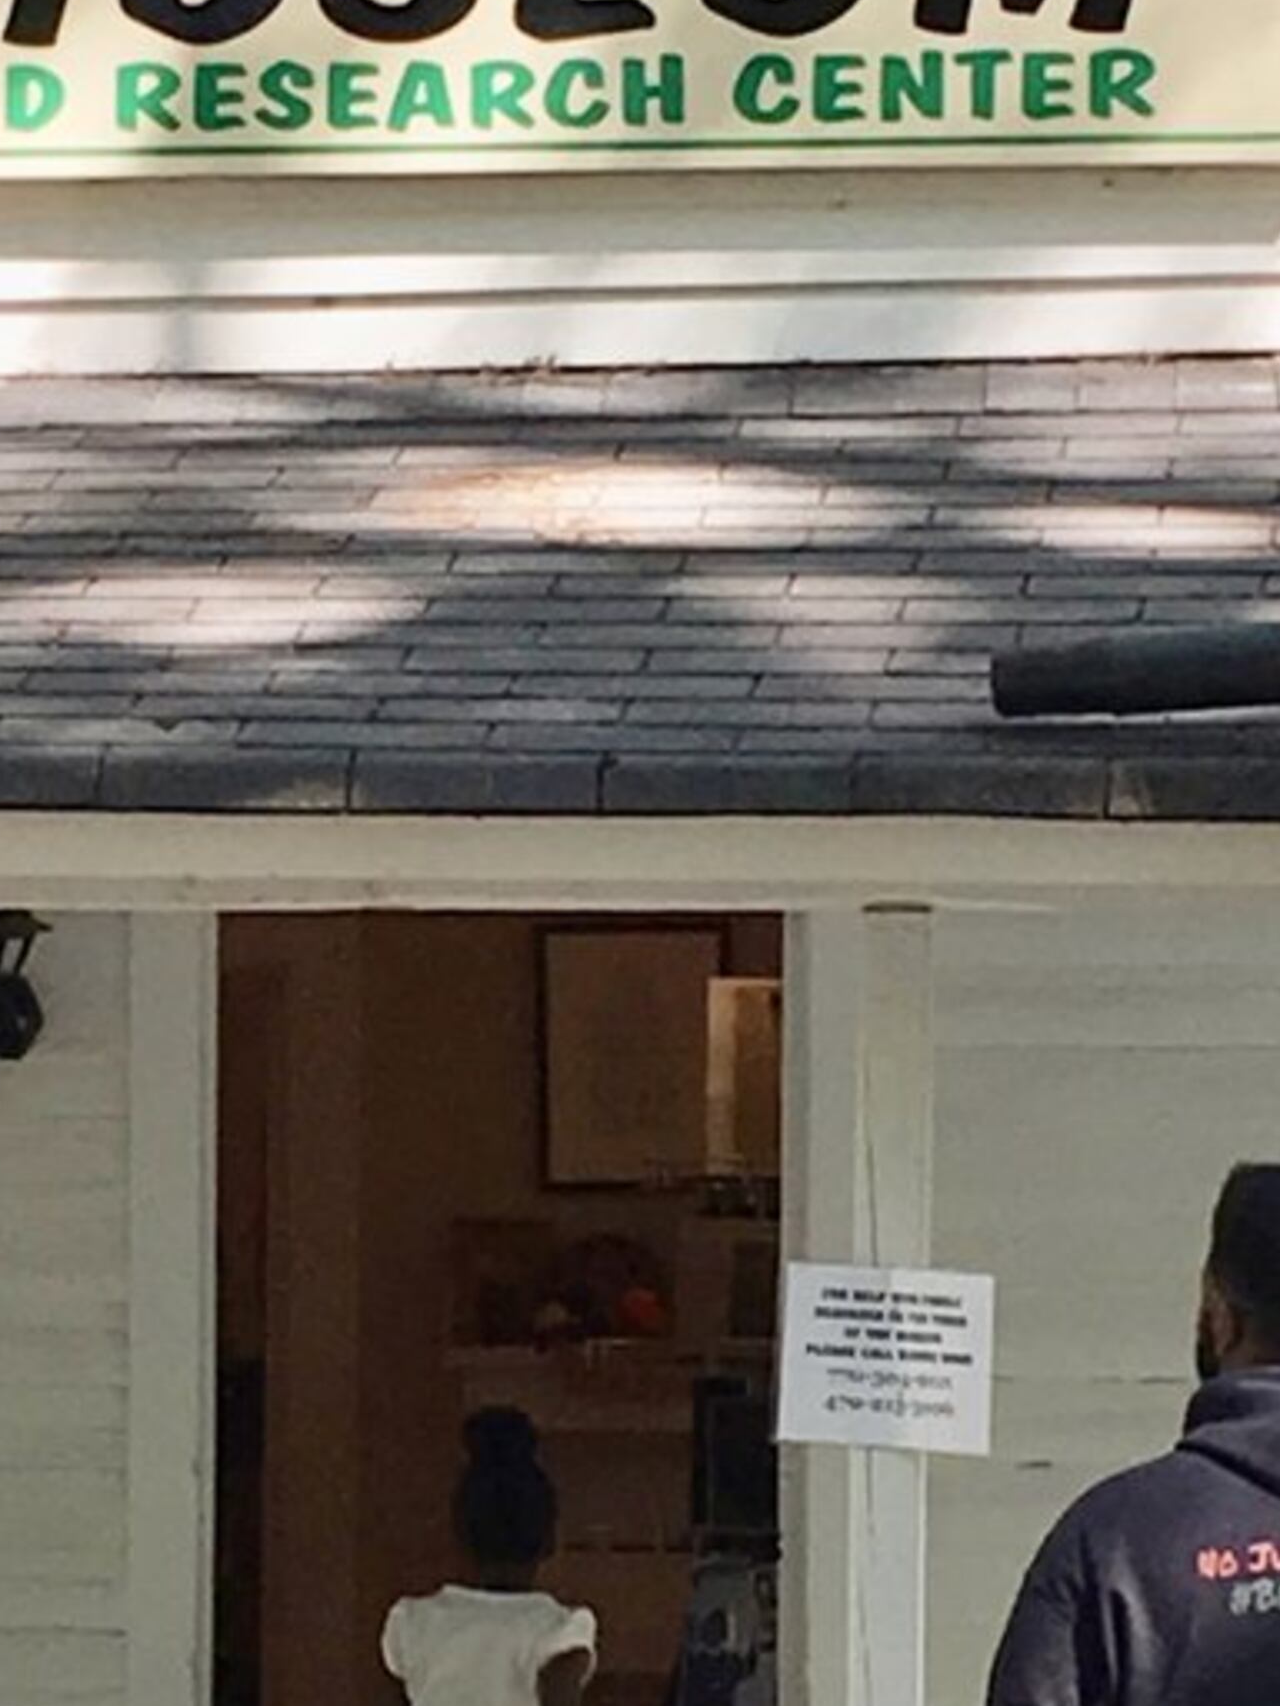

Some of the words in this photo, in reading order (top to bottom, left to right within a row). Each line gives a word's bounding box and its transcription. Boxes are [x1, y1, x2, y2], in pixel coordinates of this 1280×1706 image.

[112, 53, 685, 131] RESEARCH
[732, 46, 1157, 123] CENTER
[1197, 1546, 1238, 1580] NO
